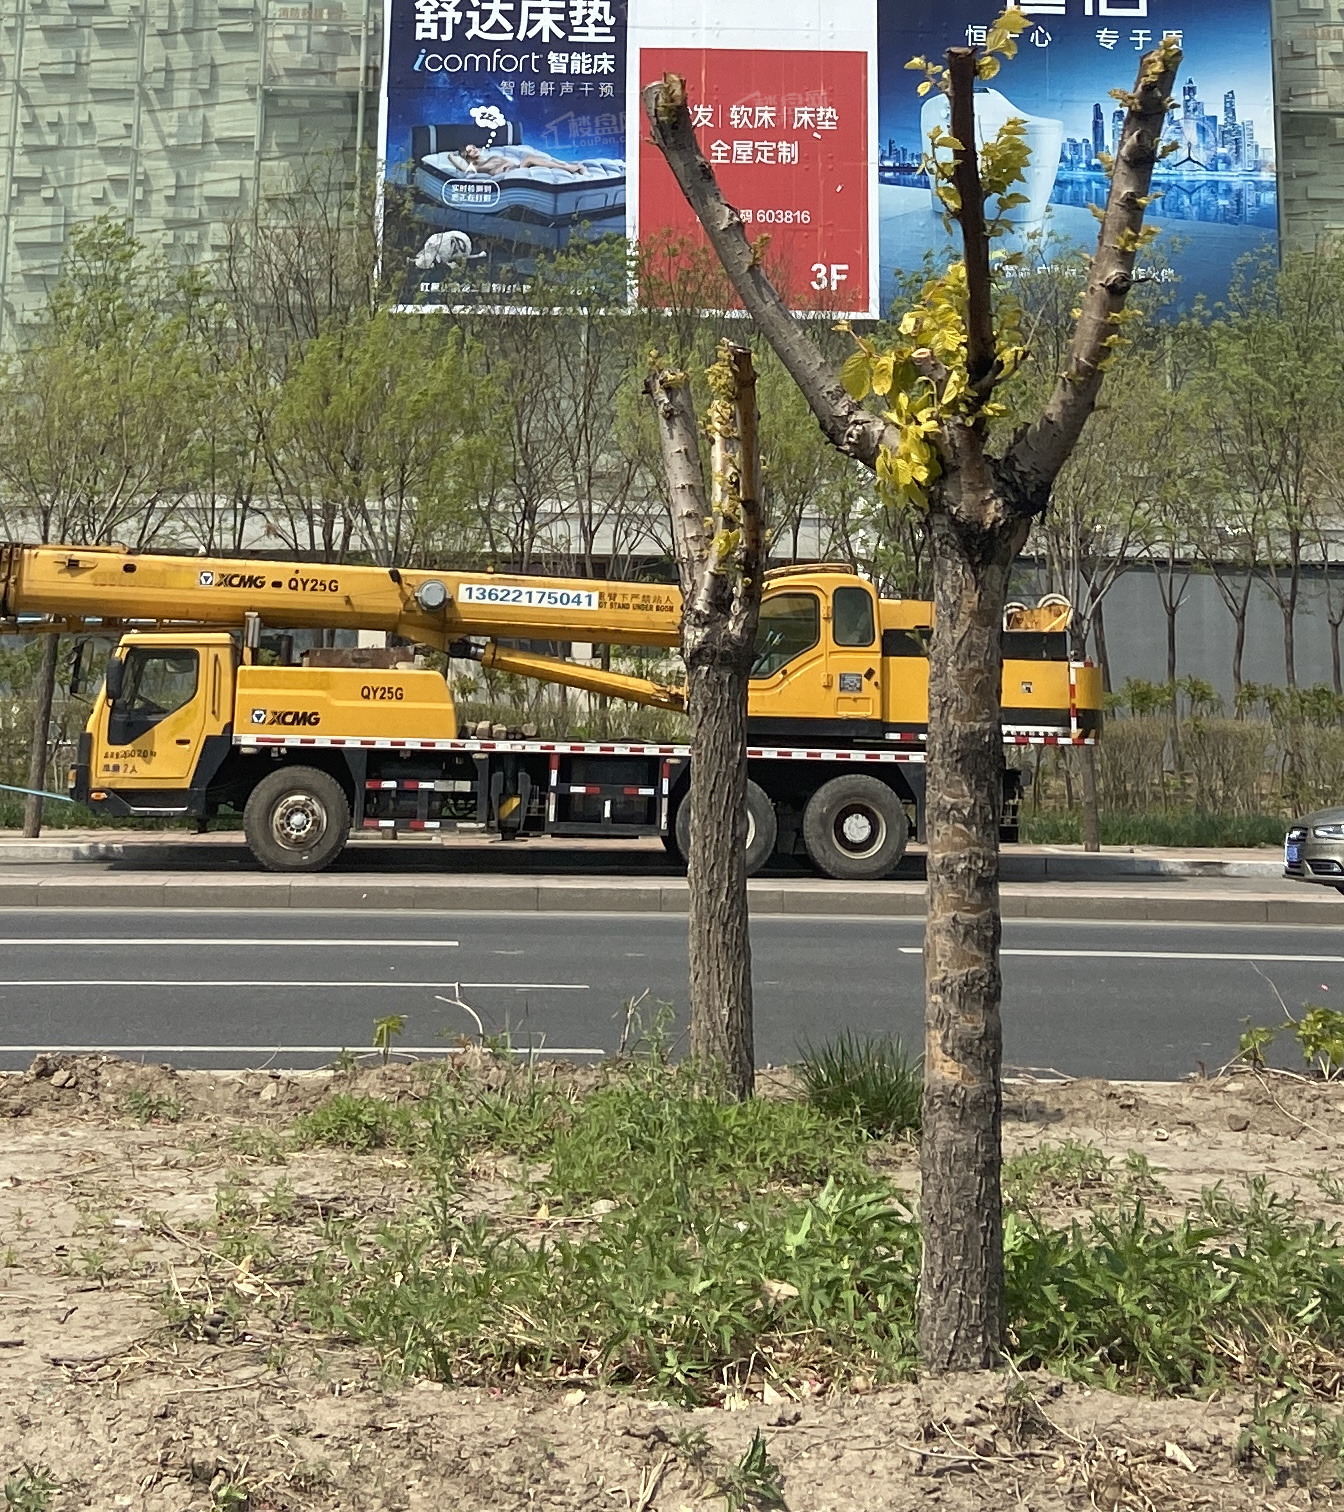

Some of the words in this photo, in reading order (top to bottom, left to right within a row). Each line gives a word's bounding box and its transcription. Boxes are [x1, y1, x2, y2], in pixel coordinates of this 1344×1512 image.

[547, 51, 616, 75] 智能床
[500, 80, 615, 98] 智能鼾声干预
[729, 105, 776, 129] 软床
[792, 106, 839, 130] 床垫
[710, 140, 800, 165] 全屋定制
[756, 209, 811, 224] 603816
[810, 263, 850, 292] 3F
[216, 572, 266, 589] XCMG
[288, 577, 339, 593] QY25G
[464, 585, 595, 609] 13622175041
[361, 686, 404, 701] QY25G
[268, 710, 321, 726] XCMG
